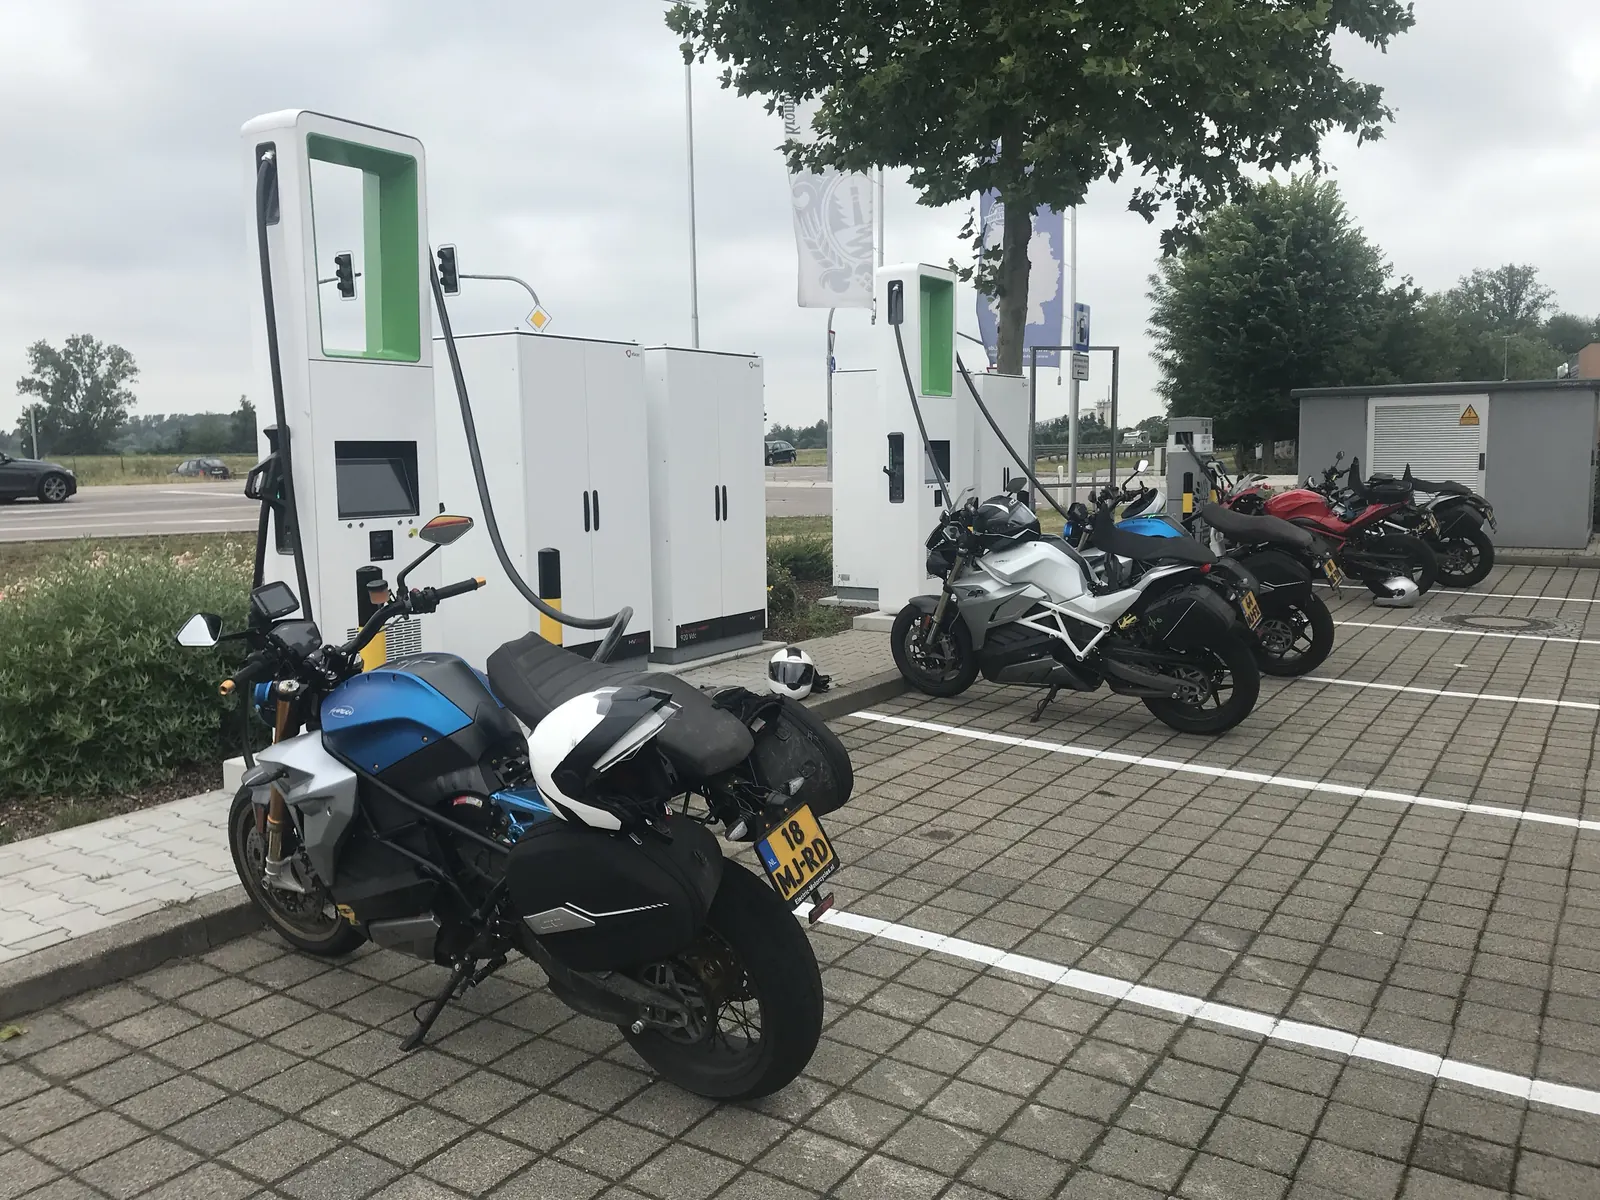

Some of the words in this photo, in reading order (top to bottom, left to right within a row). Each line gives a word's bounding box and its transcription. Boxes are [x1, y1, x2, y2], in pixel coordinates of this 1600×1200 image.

[781, 820, 805, 851] 18
[768, 858, 777, 867] NL
[775, 838, 828, 896] MJ-RD
